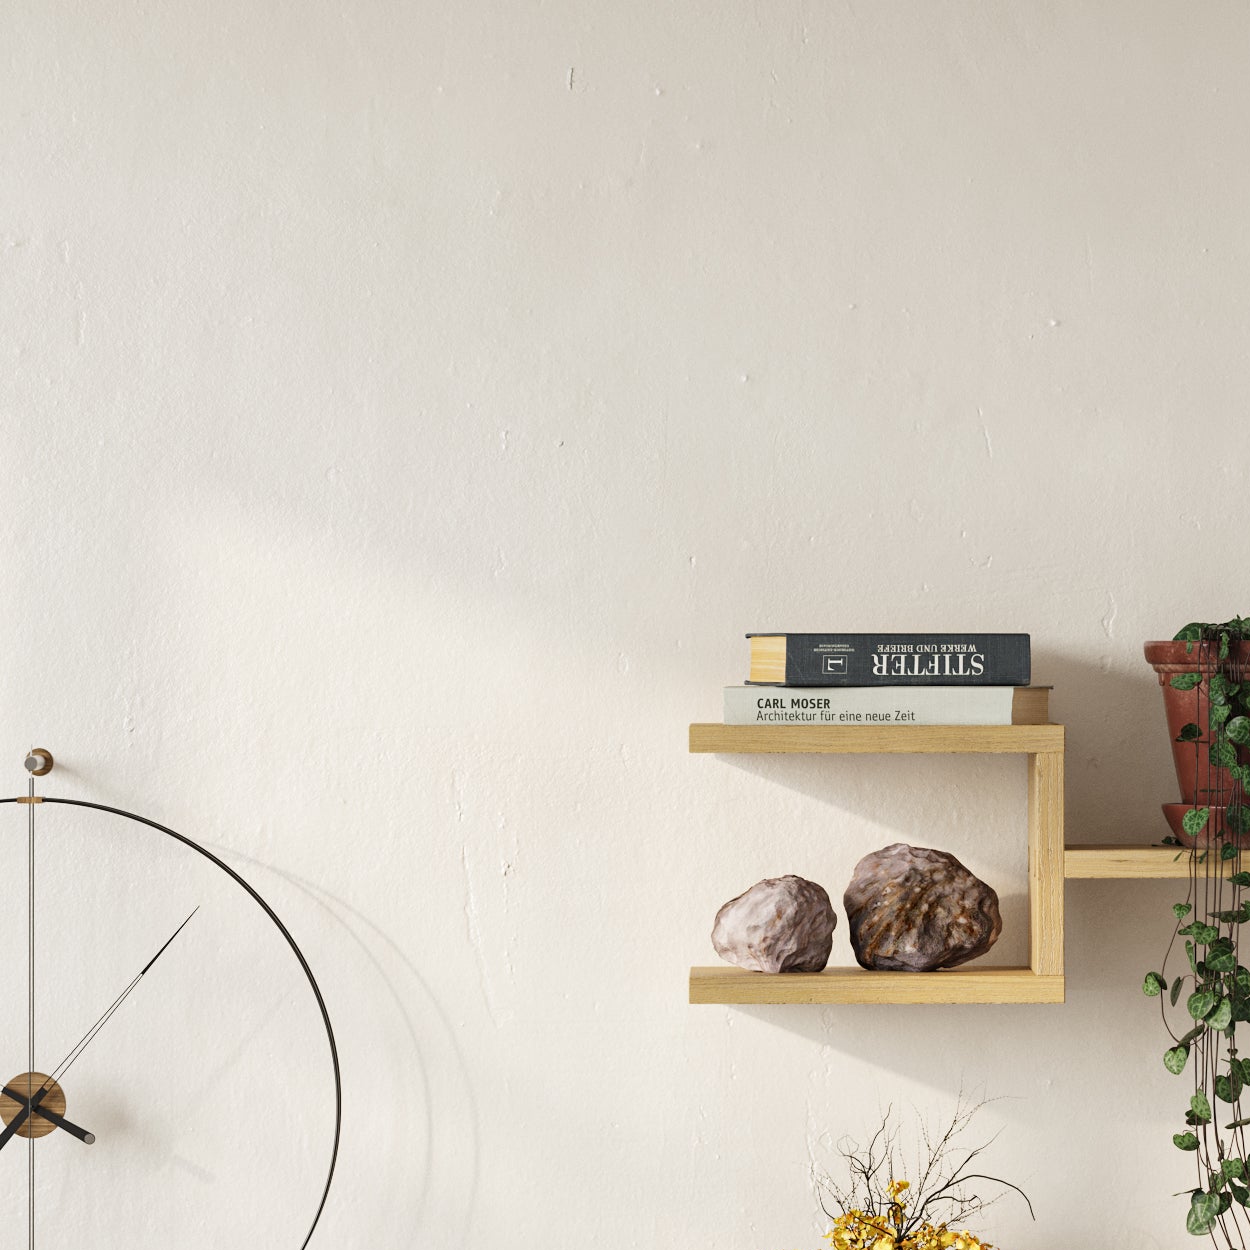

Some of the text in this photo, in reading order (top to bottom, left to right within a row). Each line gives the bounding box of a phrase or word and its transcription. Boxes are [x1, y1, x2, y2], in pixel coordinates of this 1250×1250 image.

[877, 643, 978, 653] WERKE UND BRIEFE
[872, 653, 985, 676] STIFTER
[757, 698, 831, 709] CARL MOSER
[756, 710, 916, 722] Architektur für eine neue Zeit
